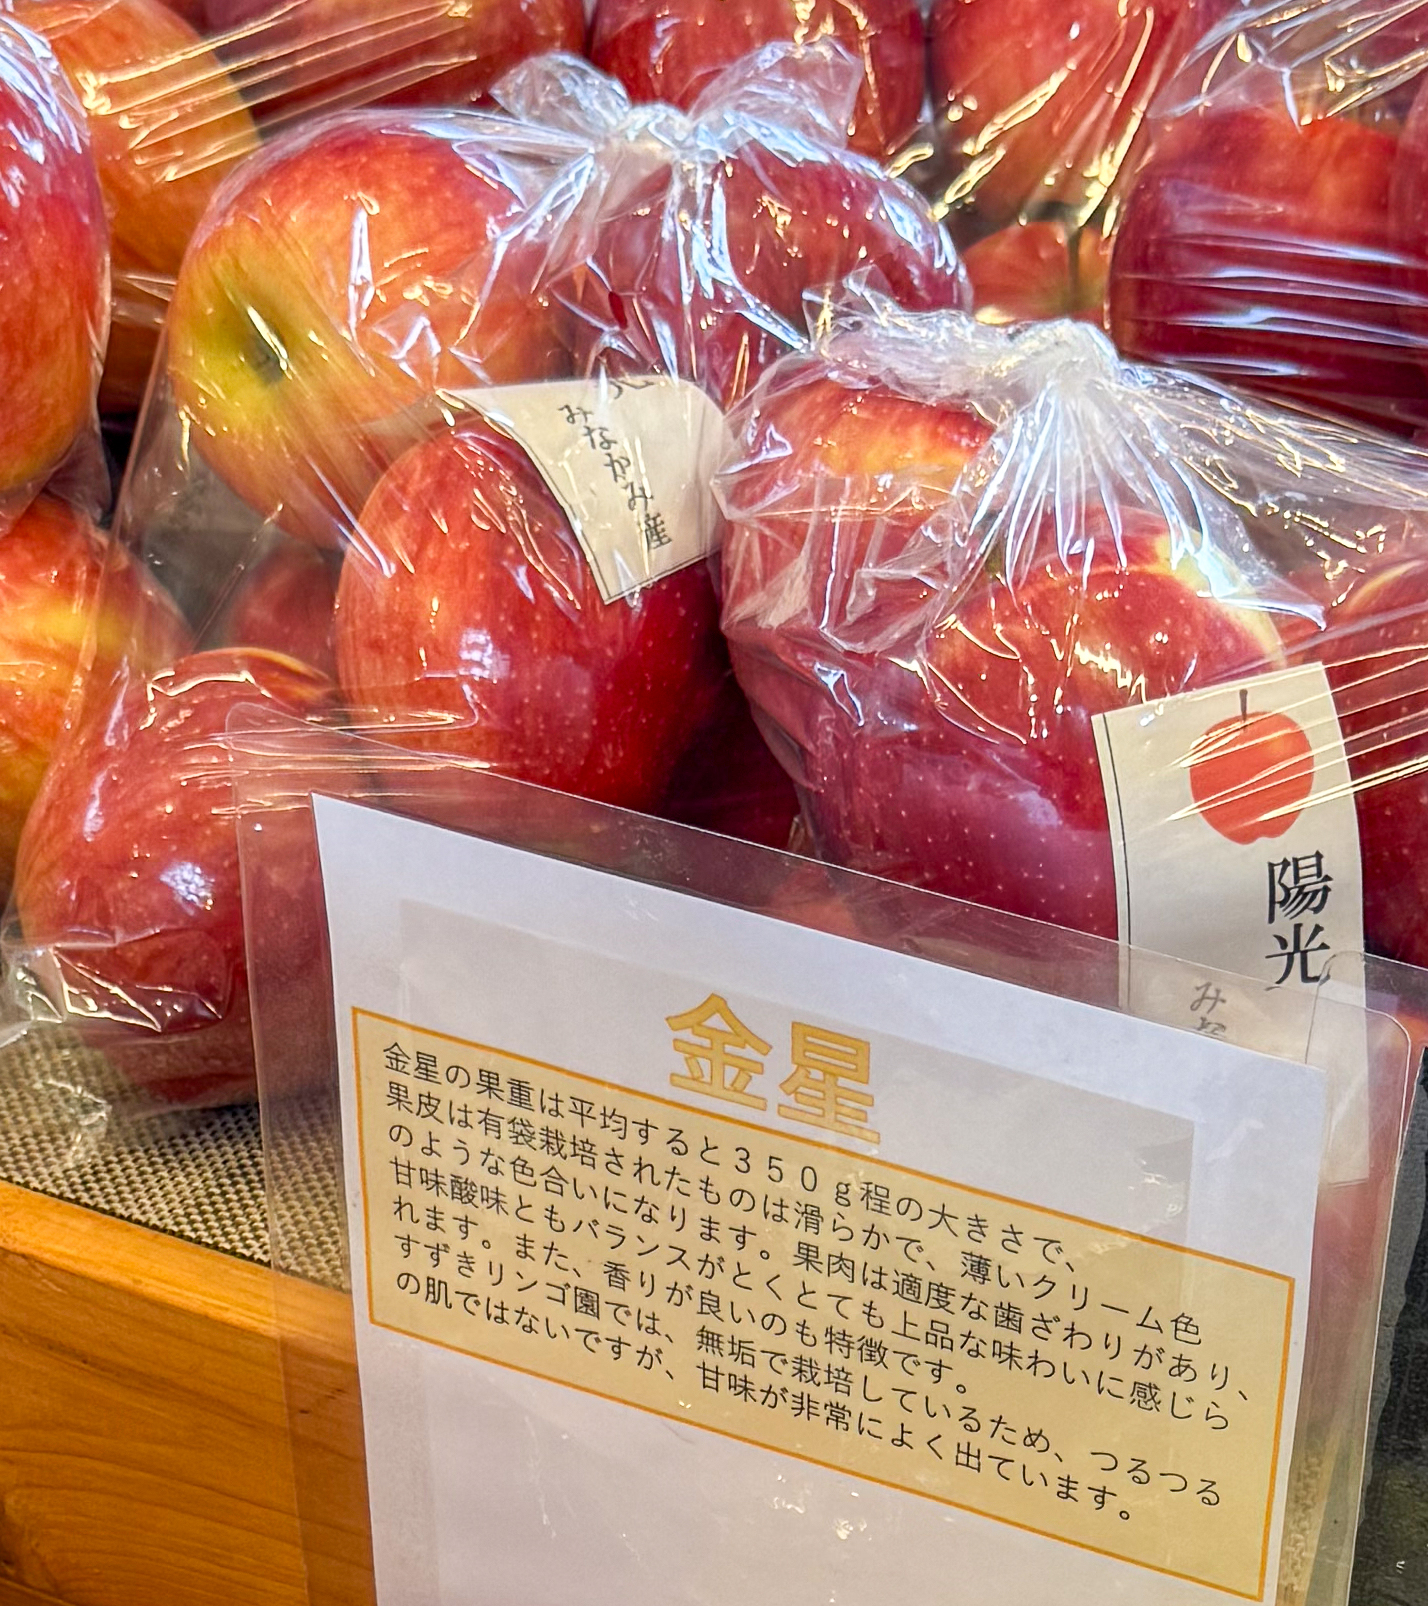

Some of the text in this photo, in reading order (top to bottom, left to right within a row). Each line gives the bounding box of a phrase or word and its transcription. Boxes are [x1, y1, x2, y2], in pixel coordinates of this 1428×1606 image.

[558, 404, 672, 551] みなかみ産
[1266, 850, 1333, 992] 陽光
[665, 993, 881, 1144] 金星
